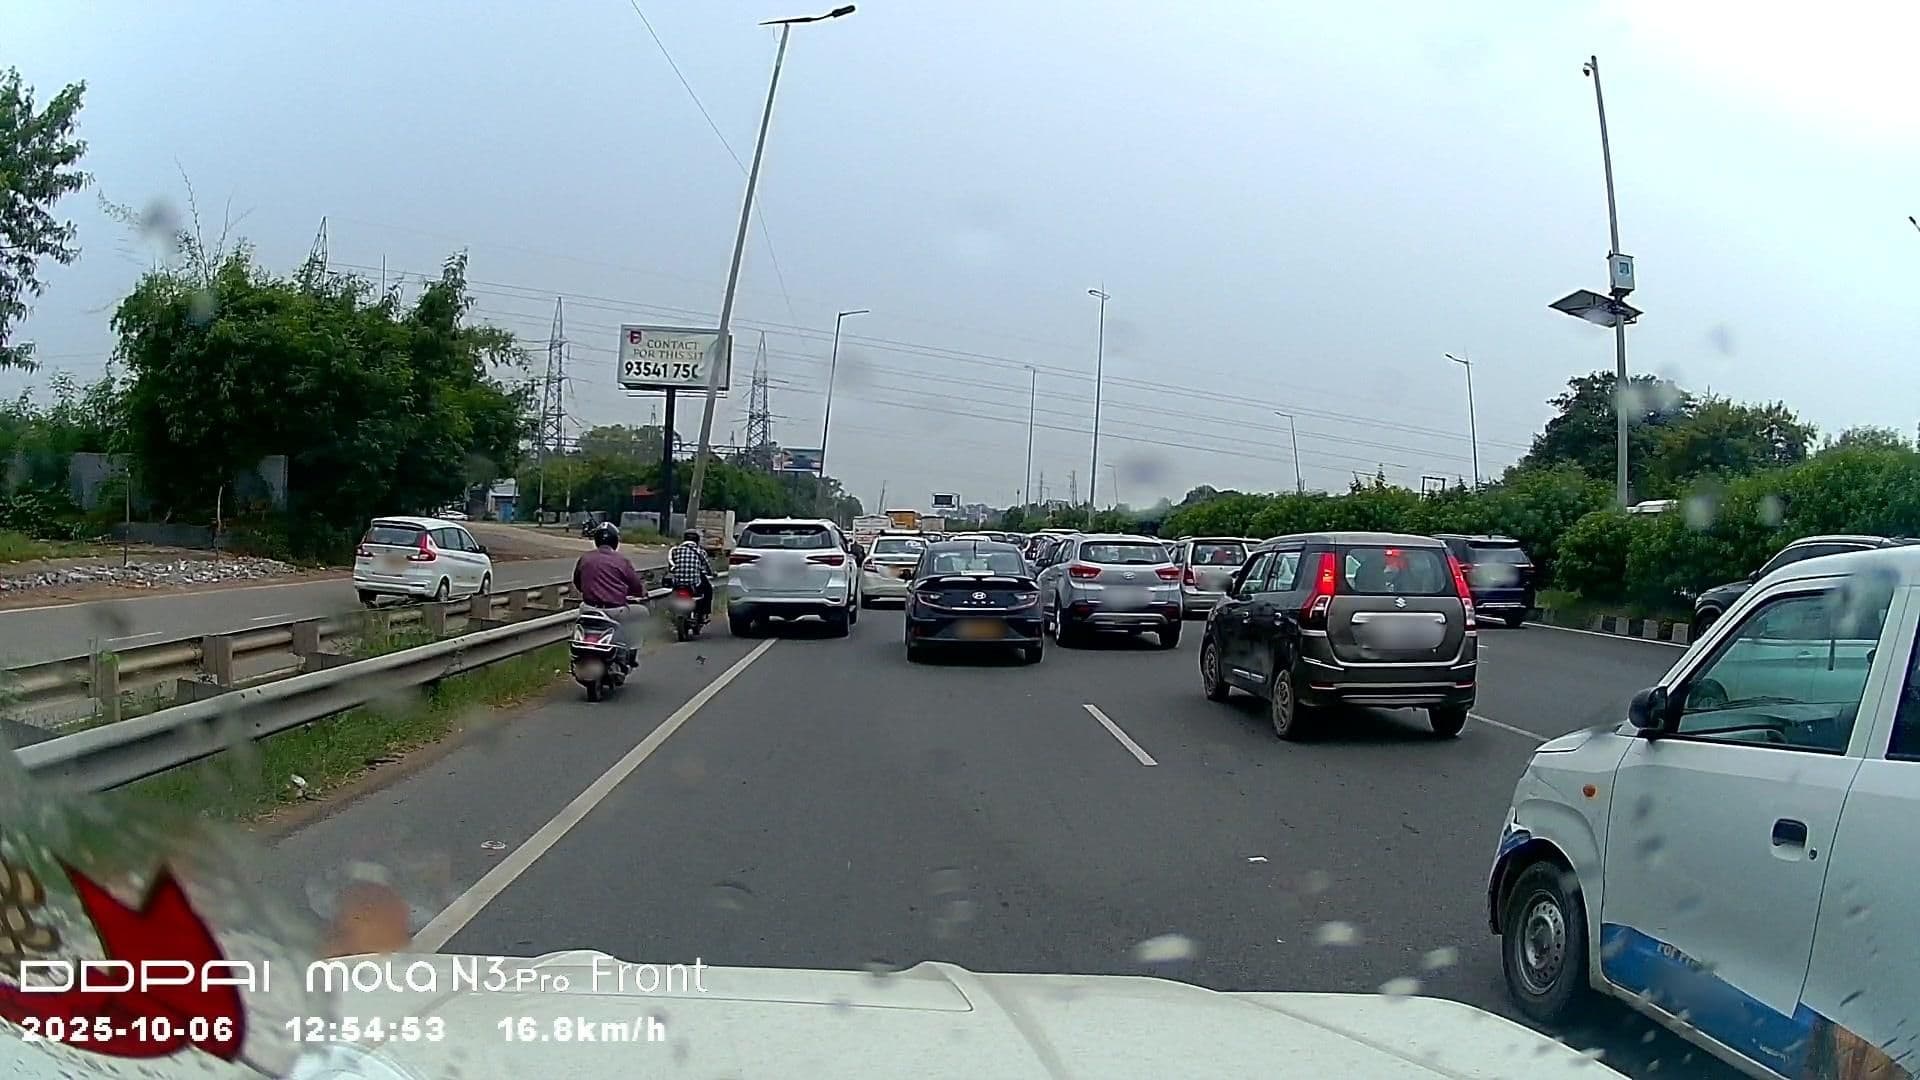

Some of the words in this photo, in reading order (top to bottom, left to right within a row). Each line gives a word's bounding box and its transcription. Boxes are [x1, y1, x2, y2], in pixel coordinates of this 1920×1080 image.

[647, 339, 697, 350] CONTACT
[633, 348, 655, 358] FOR
[660, 349, 684, 359] THIS
[625, 361, 668, 378] 93541
